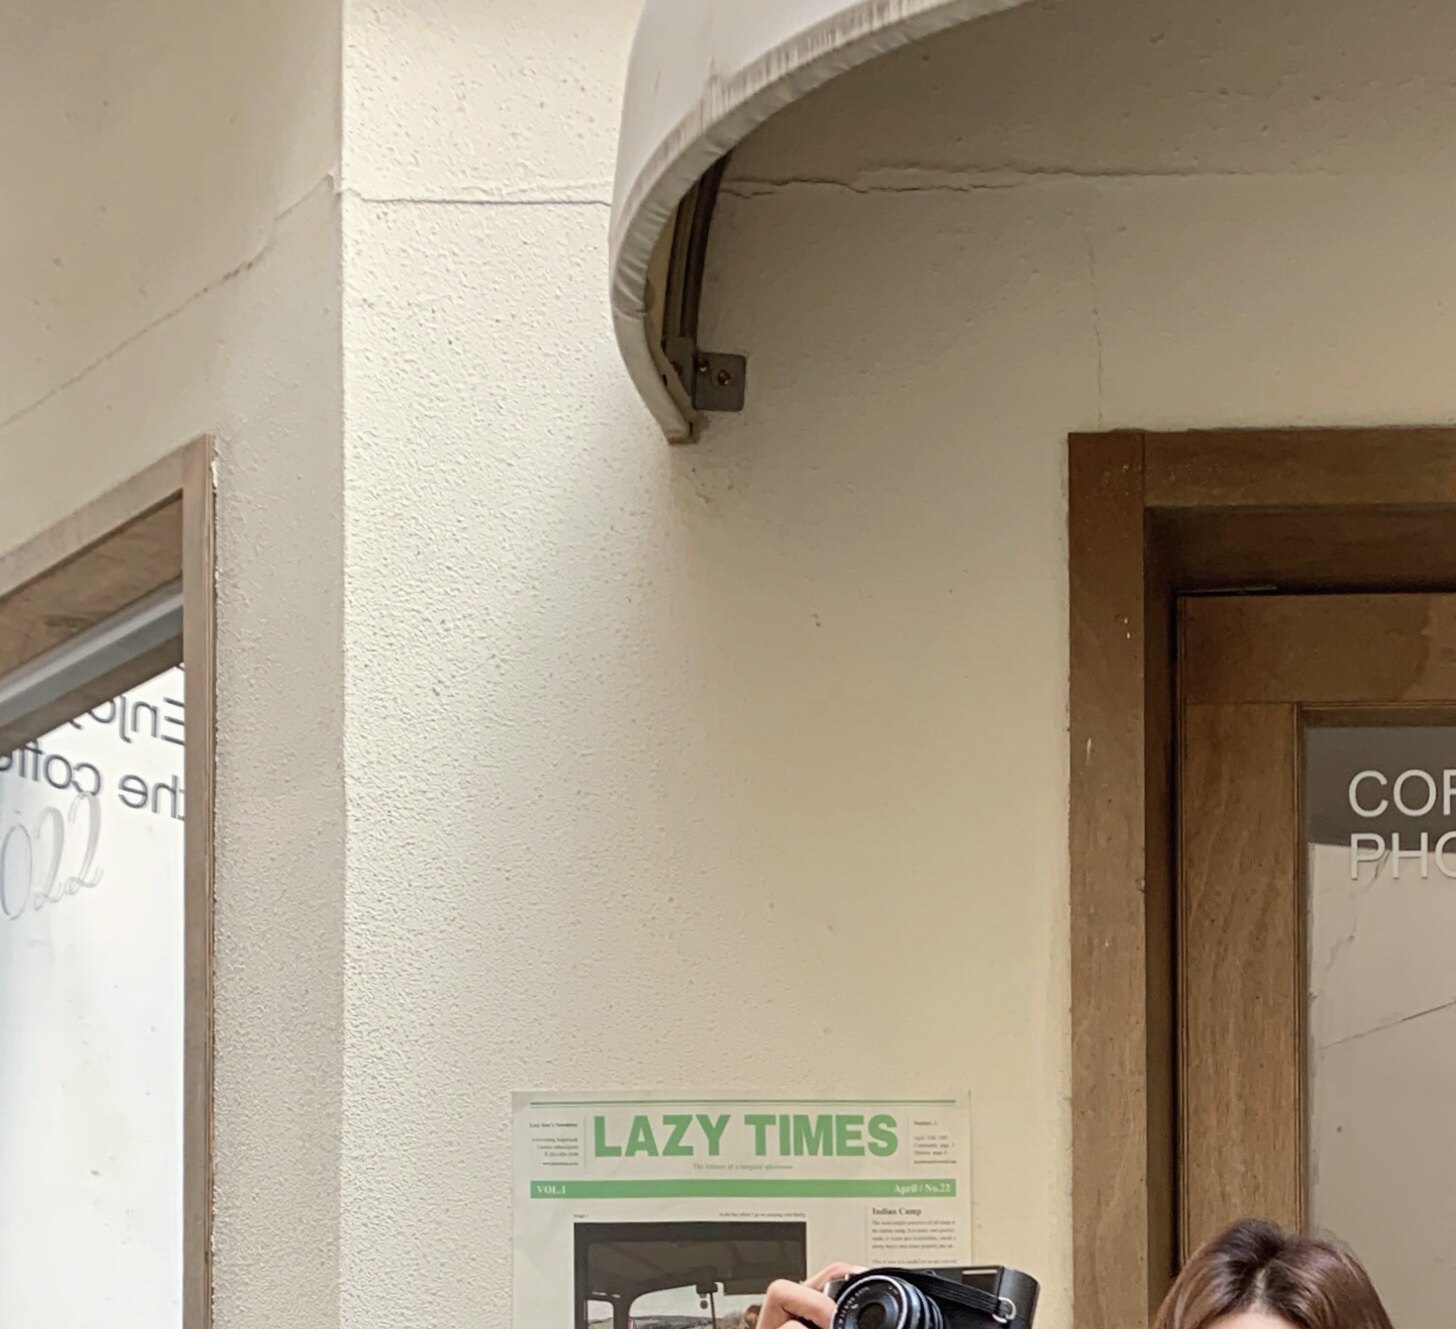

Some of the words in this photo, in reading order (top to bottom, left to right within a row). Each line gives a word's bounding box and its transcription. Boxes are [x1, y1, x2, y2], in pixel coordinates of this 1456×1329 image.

[593, 1113, 732, 1158] LAZY
[743, 1113, 898, 1157] TIMES
[536, 1184, 567, 1195] VOL.1
[894, 1184, 918, 1196] April
[898, 1206, 922, 1217] Camp
